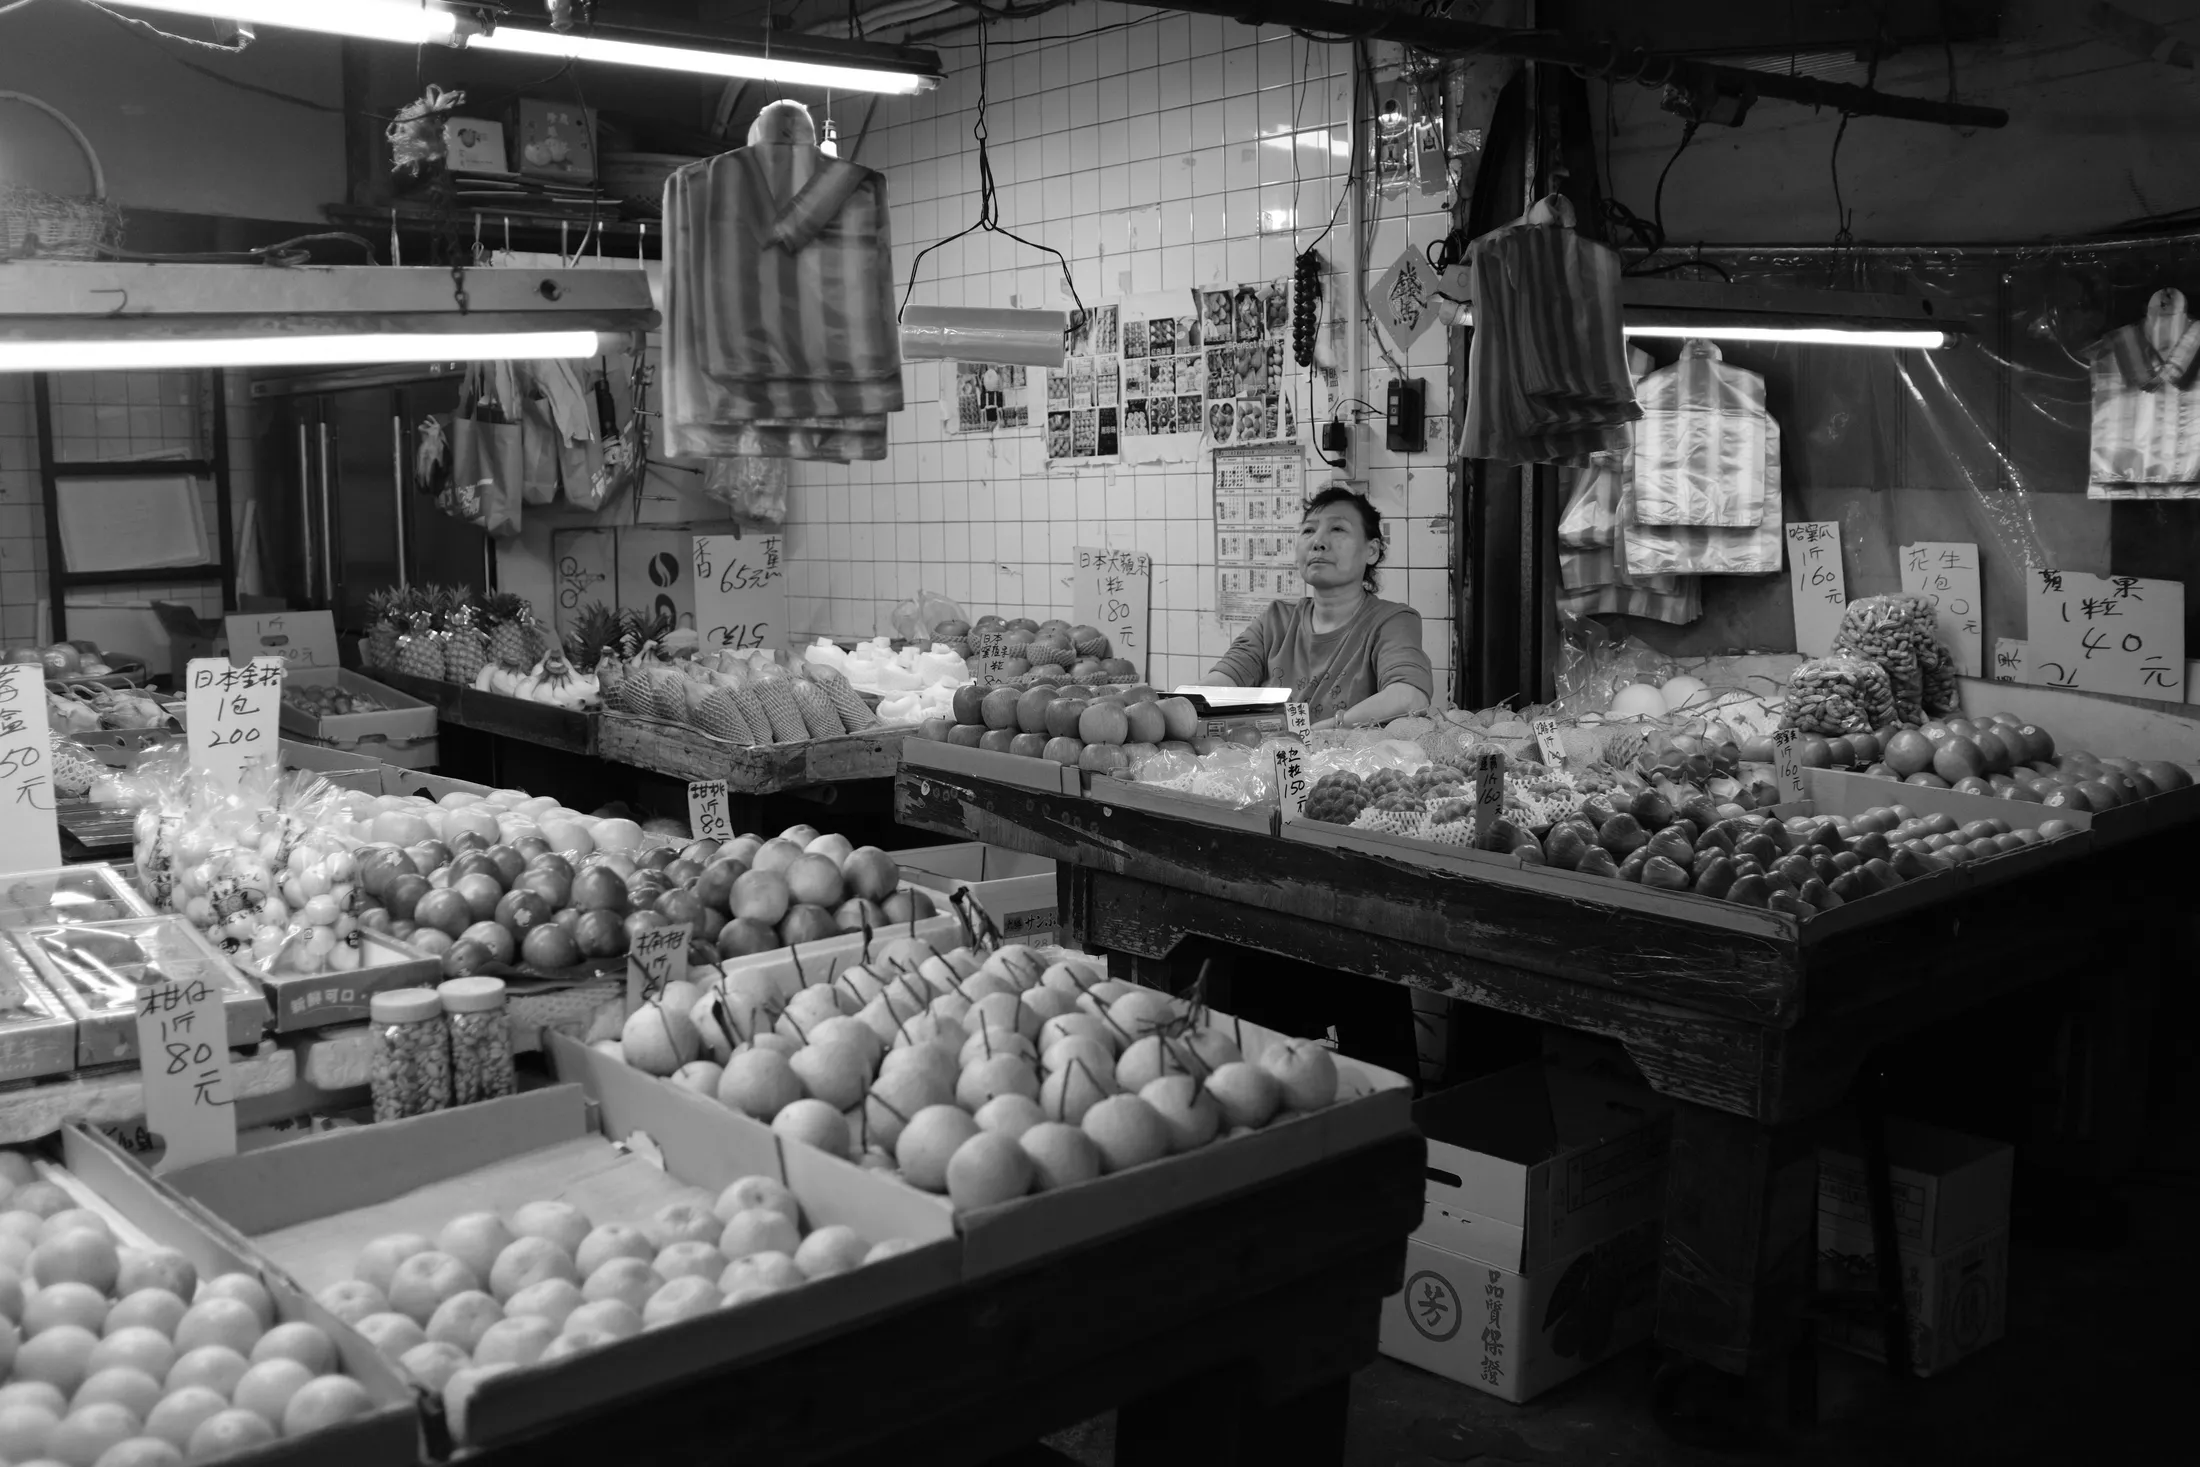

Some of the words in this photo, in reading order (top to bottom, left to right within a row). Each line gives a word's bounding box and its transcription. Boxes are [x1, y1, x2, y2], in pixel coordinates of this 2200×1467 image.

[1079, 553, 1149, 577] 日本大蘋果
[1803, 546, 1824, 566] 1斤
[1908, 548, 1974, 572] 花生
[1097, 577, 1125, 595] 1粒
[1801, 566, 1836, 591] 160
[1922, 574, 1951, 591] 1包
[1825, 588, 1844, 604] 元
[1098, 599, 1130, 622] 180
[2062, 597, 2123, 622] 1粒
[1119, 626, 1136, 647] 元
[1962, 620, 1980, 634] 元
[984, 633, 1003, 645] 日本
[2081, 627, 2143, 659] 40
[2140, 656, 2179, 687] 元
[218, 694, 260, 721] 1包
[208, 728, 260, 748] 200
[1780, 760, 1797, 777] 160
[16, 776, 57, 810] 元
[1284, 780, 1306, 798] 150
[1793, 777, 1804, 791] 元
[701, 799, 719, 816] 1斤
[1478, 788, 1501, 805] 160
[700, 814, 725, 835] 80
[161, 1011, 196, 1042] 1斤
[166, 1042, 213, 1075] 80
[194, 1069, 239, 1106] 元
[1417, 1282, 1449, 1328] 芳
[1481, 1269, 1506, 1387] 品質保證
